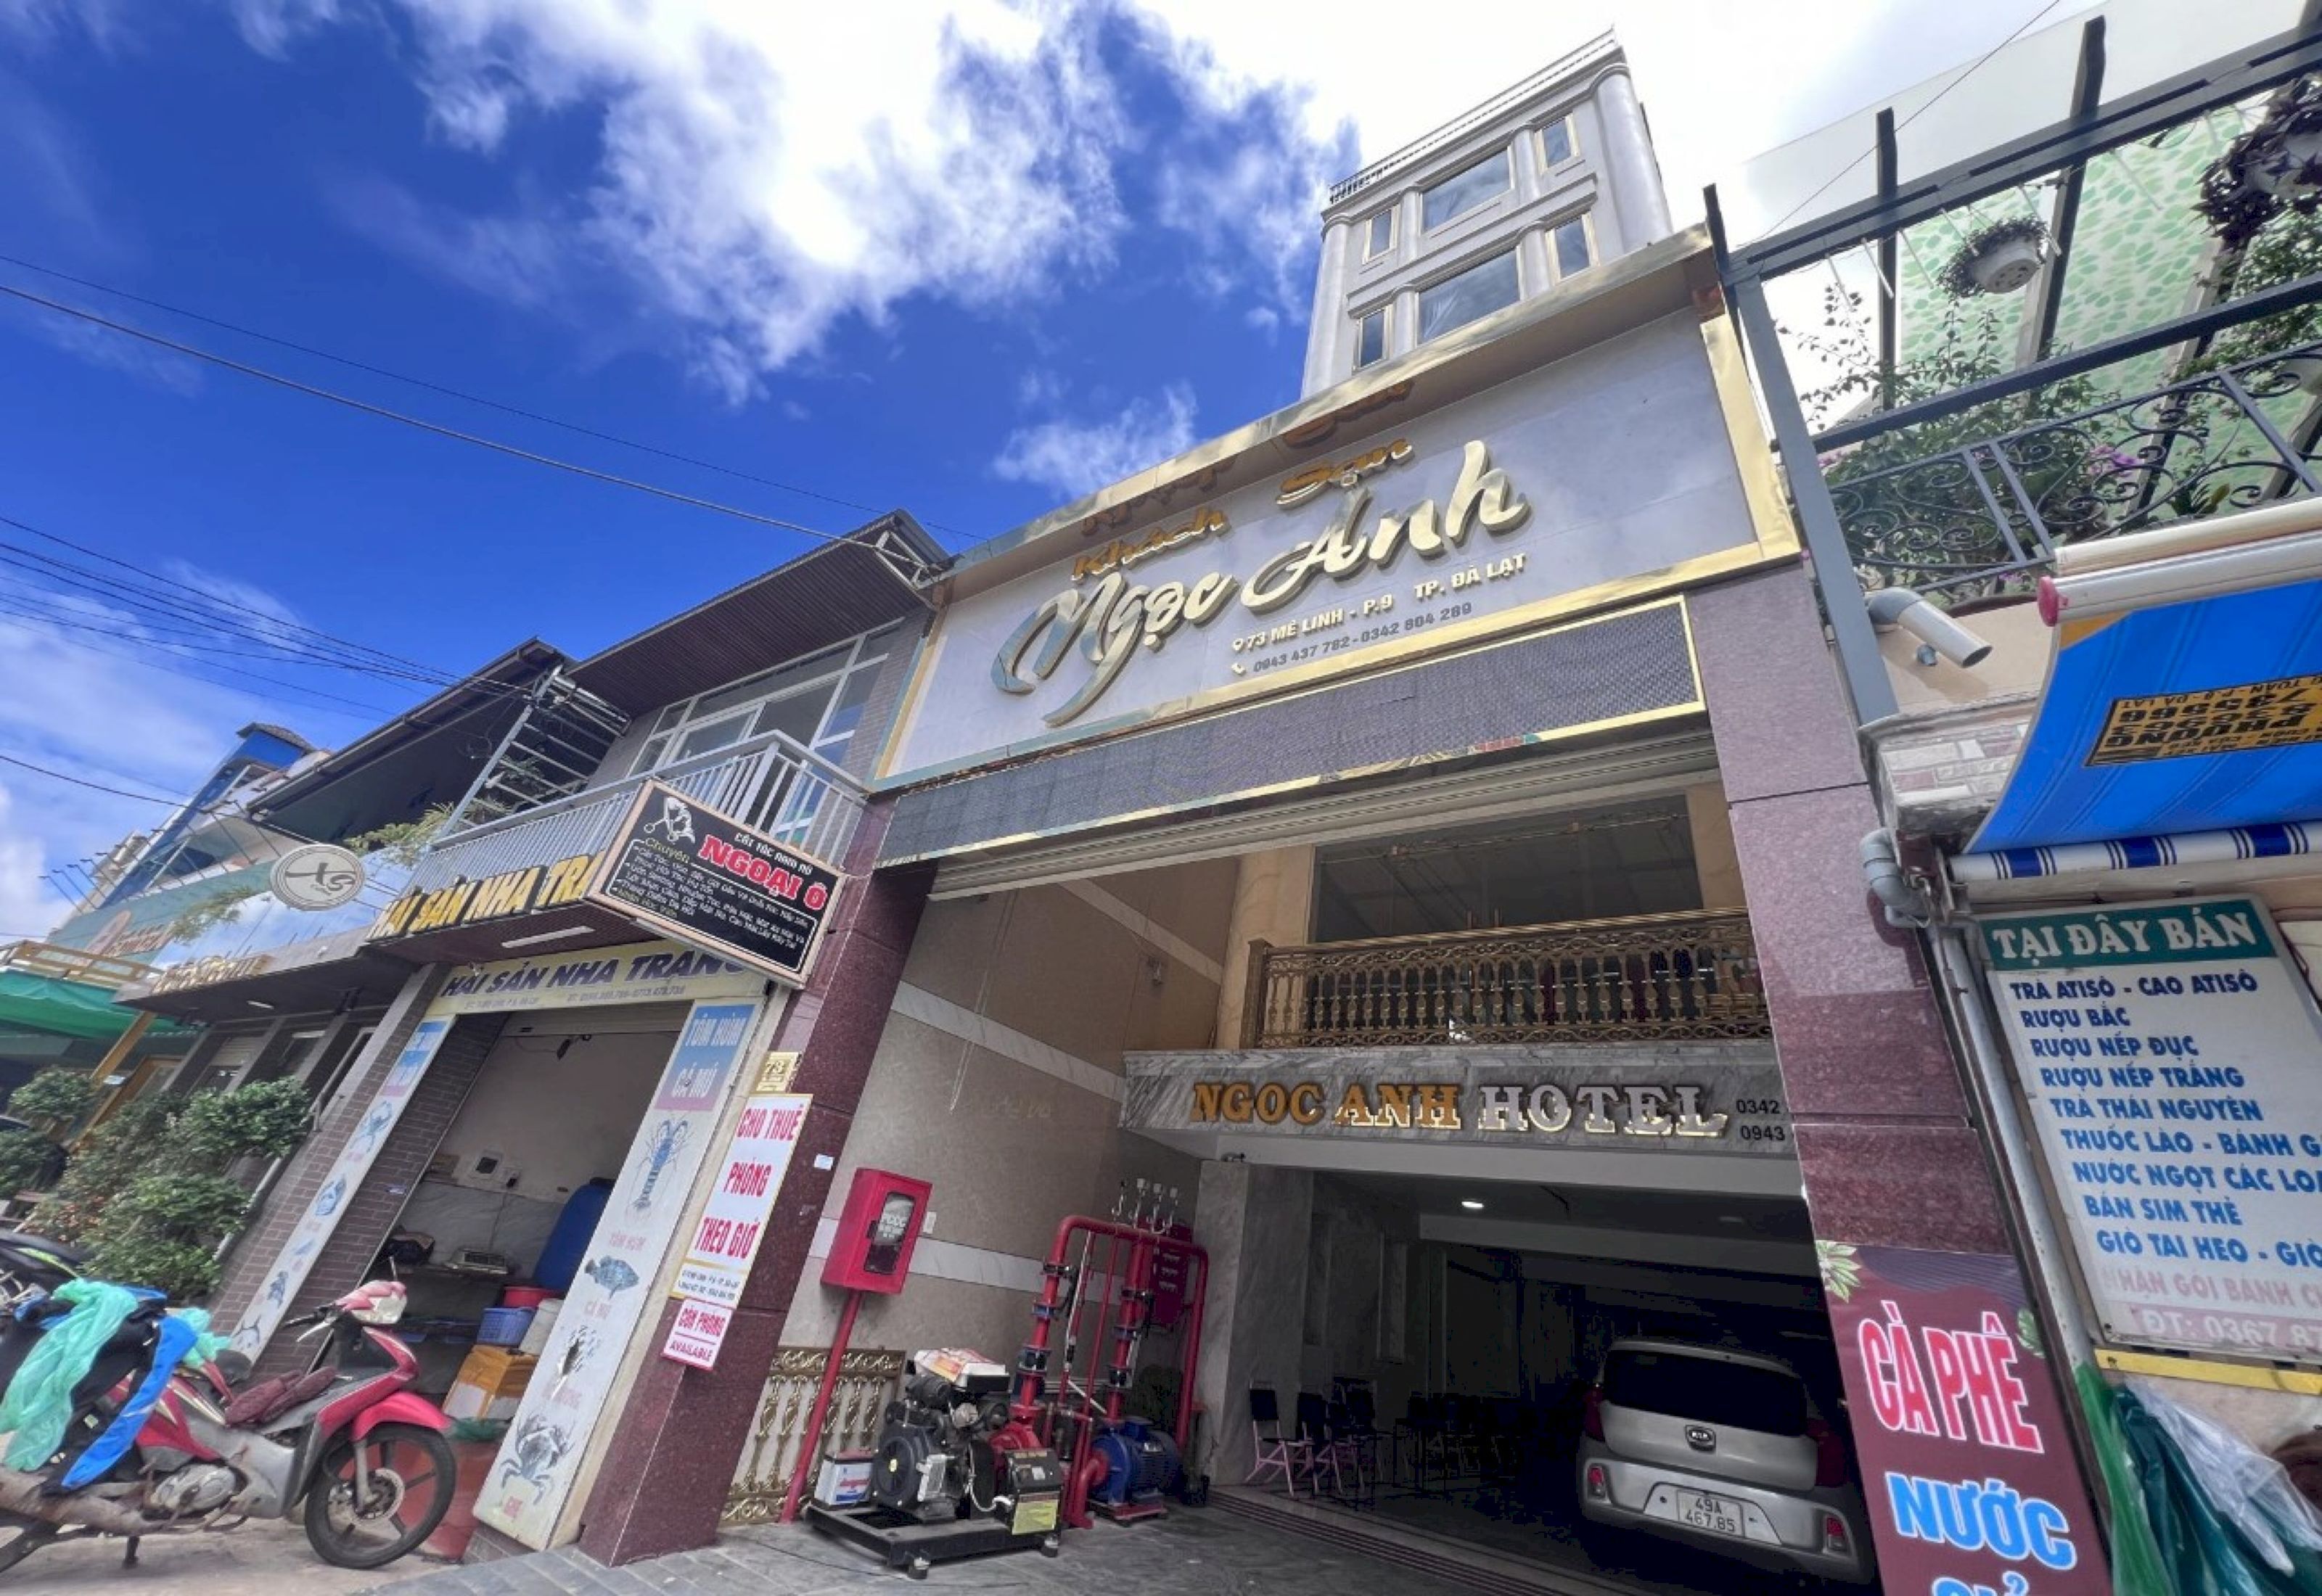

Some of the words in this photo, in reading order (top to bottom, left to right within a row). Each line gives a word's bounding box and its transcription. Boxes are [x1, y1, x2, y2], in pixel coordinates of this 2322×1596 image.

[990, 572, 1239, 728] Ngọc
[1240, 440, 1528, 613] Ánh
[1247, 633, 1267, 649] 73
[1271, 622, 1297, 643] MÊ
[1302, 609, 1343, 633] LINH
[1363, 594, 1393, 615] P.9
[1414, 583, 1445, 599] TP.
[1453, 565, 1480, 590] ĐÀ
[1488, 554, 1526, 580] LẠT
[1253, 656, 1287, 672] 0943
[1290, 645, 1318, 662] 437
[697, 834, 803, 900] NGOẠI
[803, 882, 828, 910] Ô
[408, 874, 478, 932] SẢN
[463, 866, 541, 921] NHA
[1992, 926, 2062, 966] TẠI
[2064, 914, 2151, 955] ĐÂY
[2158, 907, 2257, 950] BÁN
[440, 966, 488, 997] HẢI
[486, 961, 549, 993] SẢN
[547, 959, 620, 987] NHA
[2010, 979, 2050, 1000] TRÀ
[2056, 976, 2115, 999] ATISÔ
[2138, 976, 2183, 996] CAO
[2191, 968, 2258, 993] ATISÔ
[2020, 1009, 2081, 1032] RƯỢU
[2085, 1001, 2131, 1027] BẮC
[2030, 1038, 2092, 1061] RƯỢU
[2097, 1031, 2141, 1056] NẾP
[2147, 1036, 2199, 1061] ĐỤC
[2040, 1067, 2103, 1091] RƯỢU
[2108, 1061, 2154, 1088] NẾP
[2159, 1059, 2244, 1088] TRẮNG
[737, 1108, 768, 1138] CHO
[765, 1103, 804, 1140] THUÊ
[1190, 1082, 1326, 1124] NGOC
[1332, 1083, 1461, 1130] ANH
[1478, 1085, 1728, 1136] HOTEL
[1736, 1098, 1781, 1114] 0342
[2050, 1094, 2094, 1118] TRÀ
[2097, 1095, 2154, 1119] THÁI
[2157, 1095, 2264, 1121] NGUYÊN
[1741, 1125, 1785, 1141] 0943
[2060, 1124, 2139, 1151] THUỐC
[2144, 1126, 2194, 1153] LÀO
[2218, 1128, 2294, 1156] BÁNH
[2300, 1133, 2322, 1157] G
[723, 1157, 771, 1197] PHÒNG
[2072, 1159, 2141, 1185] NƯỚC
[2145, 1164, 2216, 1194] NGỌT
[2224, 1162, 2275, 1190] CÁC
[2083, 1190, 2135, 1219] BÁN
[2141, 1198, 2188, 1222] SIM
[2191, 1196, 2243, 1225] THẺ
[695, 1217, 731, 1254] THEO
[728, 1218, 760, 1259] GIỜ
[2096, 1227, 2143, 1254] GIÒ
[2147, 1233, 2188, 1258] TAI
[2193, 1236, 2248, 1262] HEO
[2106, 1269, 2168, 1298] HẬN
[678, 1305, 697, 1328] CÒN
[694, 1311, 726, 1337] PHÒNG
[2141, 1309, 2196, 1337] ĐT:
[2204, 1315, 2278, 1347] 0367
[670, 1339, 713, 1362] AVAILABLE
[1858, 1300, 1940, 1437] CÀ
[1921, 1311, 2044, 1454] PHÊ
[1696, 1497, 1722, 1514] 49A
[1884, 1471, 2077, 1571] NƯỚC
